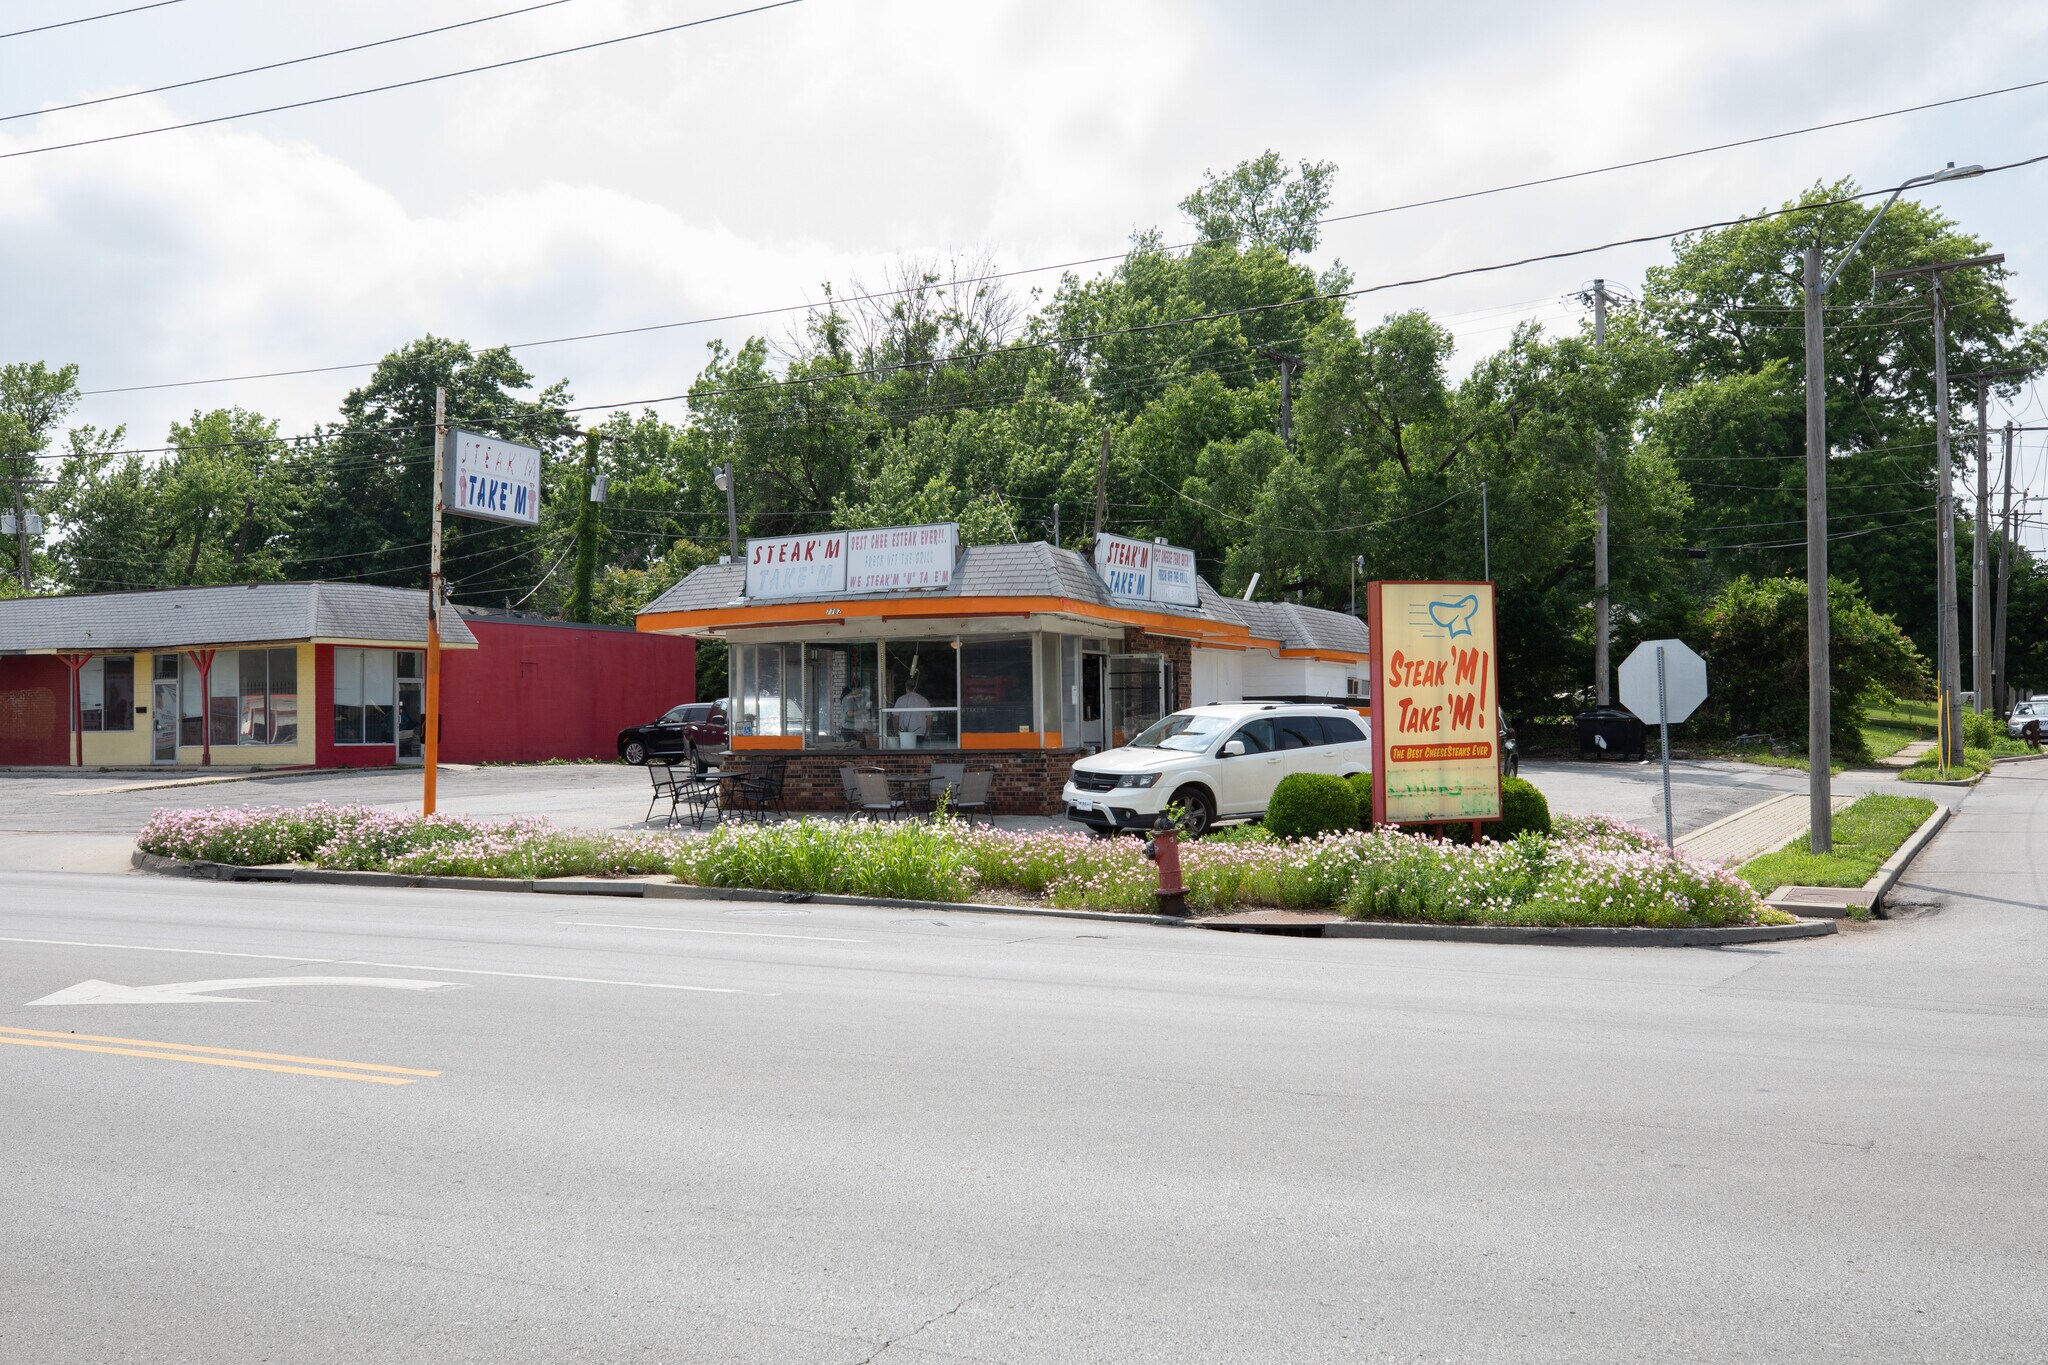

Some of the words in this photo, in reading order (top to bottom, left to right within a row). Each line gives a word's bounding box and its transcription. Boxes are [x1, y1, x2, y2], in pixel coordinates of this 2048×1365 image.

[469, 475, 527, 515] TAKE'M
[753, 539, 840, 565] STEAK'M
[1107, 542, 1149, 569] STEAK'M
[850, 575, 861, 588] WE
[1110, 570, 1145, 596] TAKE'M
[1393, 747, 1405, 759] THE
[1407, 746, 1423, 759] BEST
[1472, 744, 1488, 756] EVER
